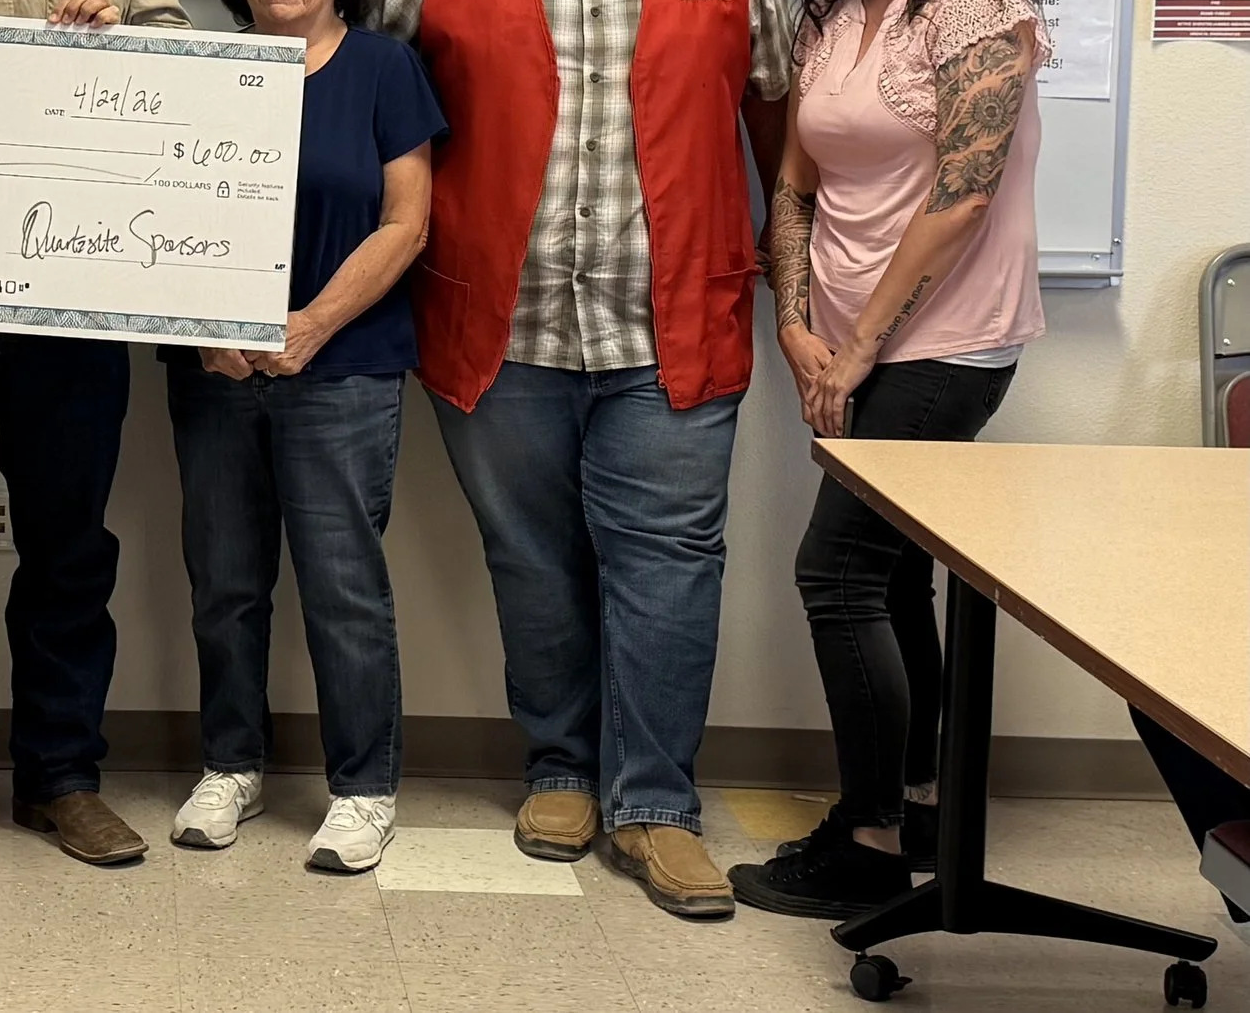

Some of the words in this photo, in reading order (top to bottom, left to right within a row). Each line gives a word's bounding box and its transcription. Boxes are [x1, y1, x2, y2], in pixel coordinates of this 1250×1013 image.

[1043, 58, 1063, 69] 45!
[239, 73, 264, 88] 022
[73, 75, 163, 117] 4/29/26
[173, 142, 185, 160] $
[172, 180, 212, 191] DOLLARS
